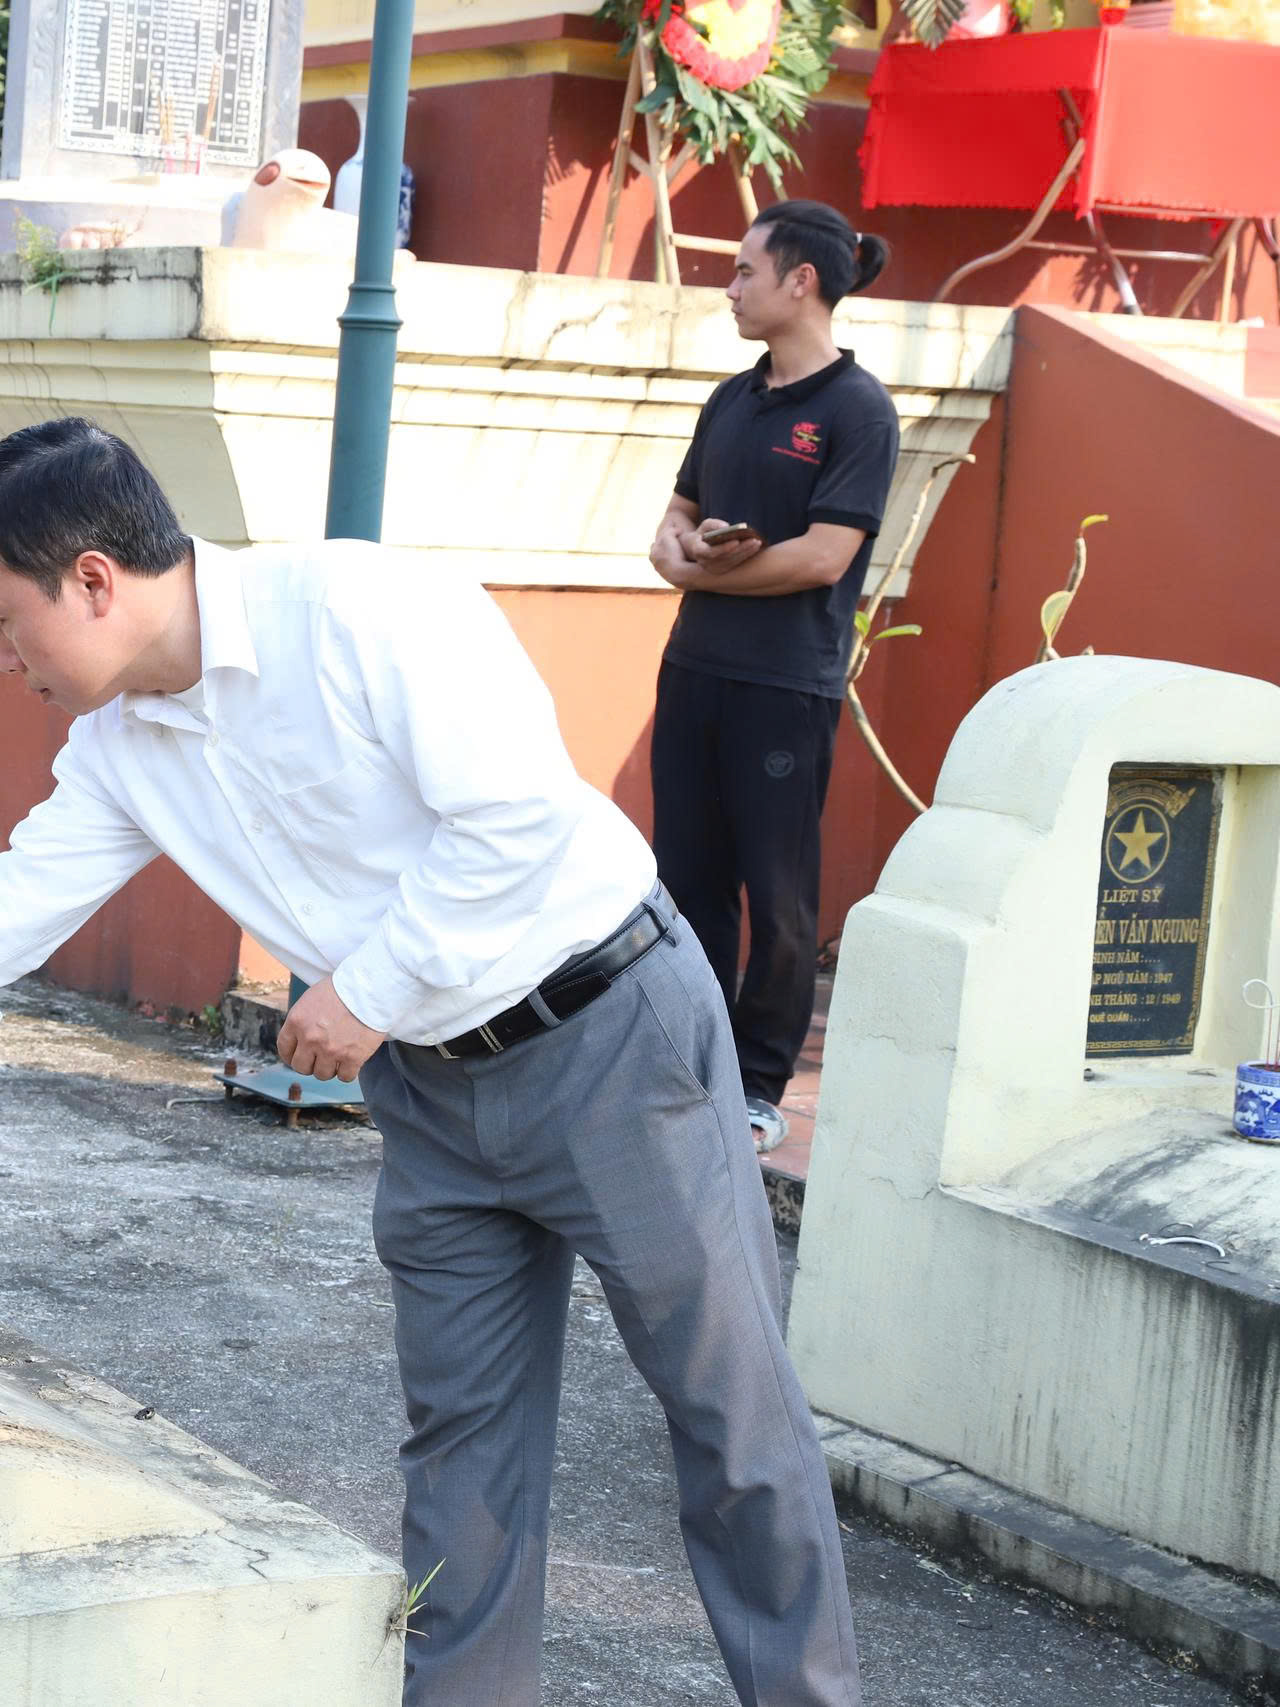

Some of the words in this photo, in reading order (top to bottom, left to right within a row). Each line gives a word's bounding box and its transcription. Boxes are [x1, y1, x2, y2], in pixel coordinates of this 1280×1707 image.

[1102, 885, 1138, 906] LIỆT
[1119, 912, 1149, 944] VĂN
[1103, 991, 1137, 1006] THÁNG
